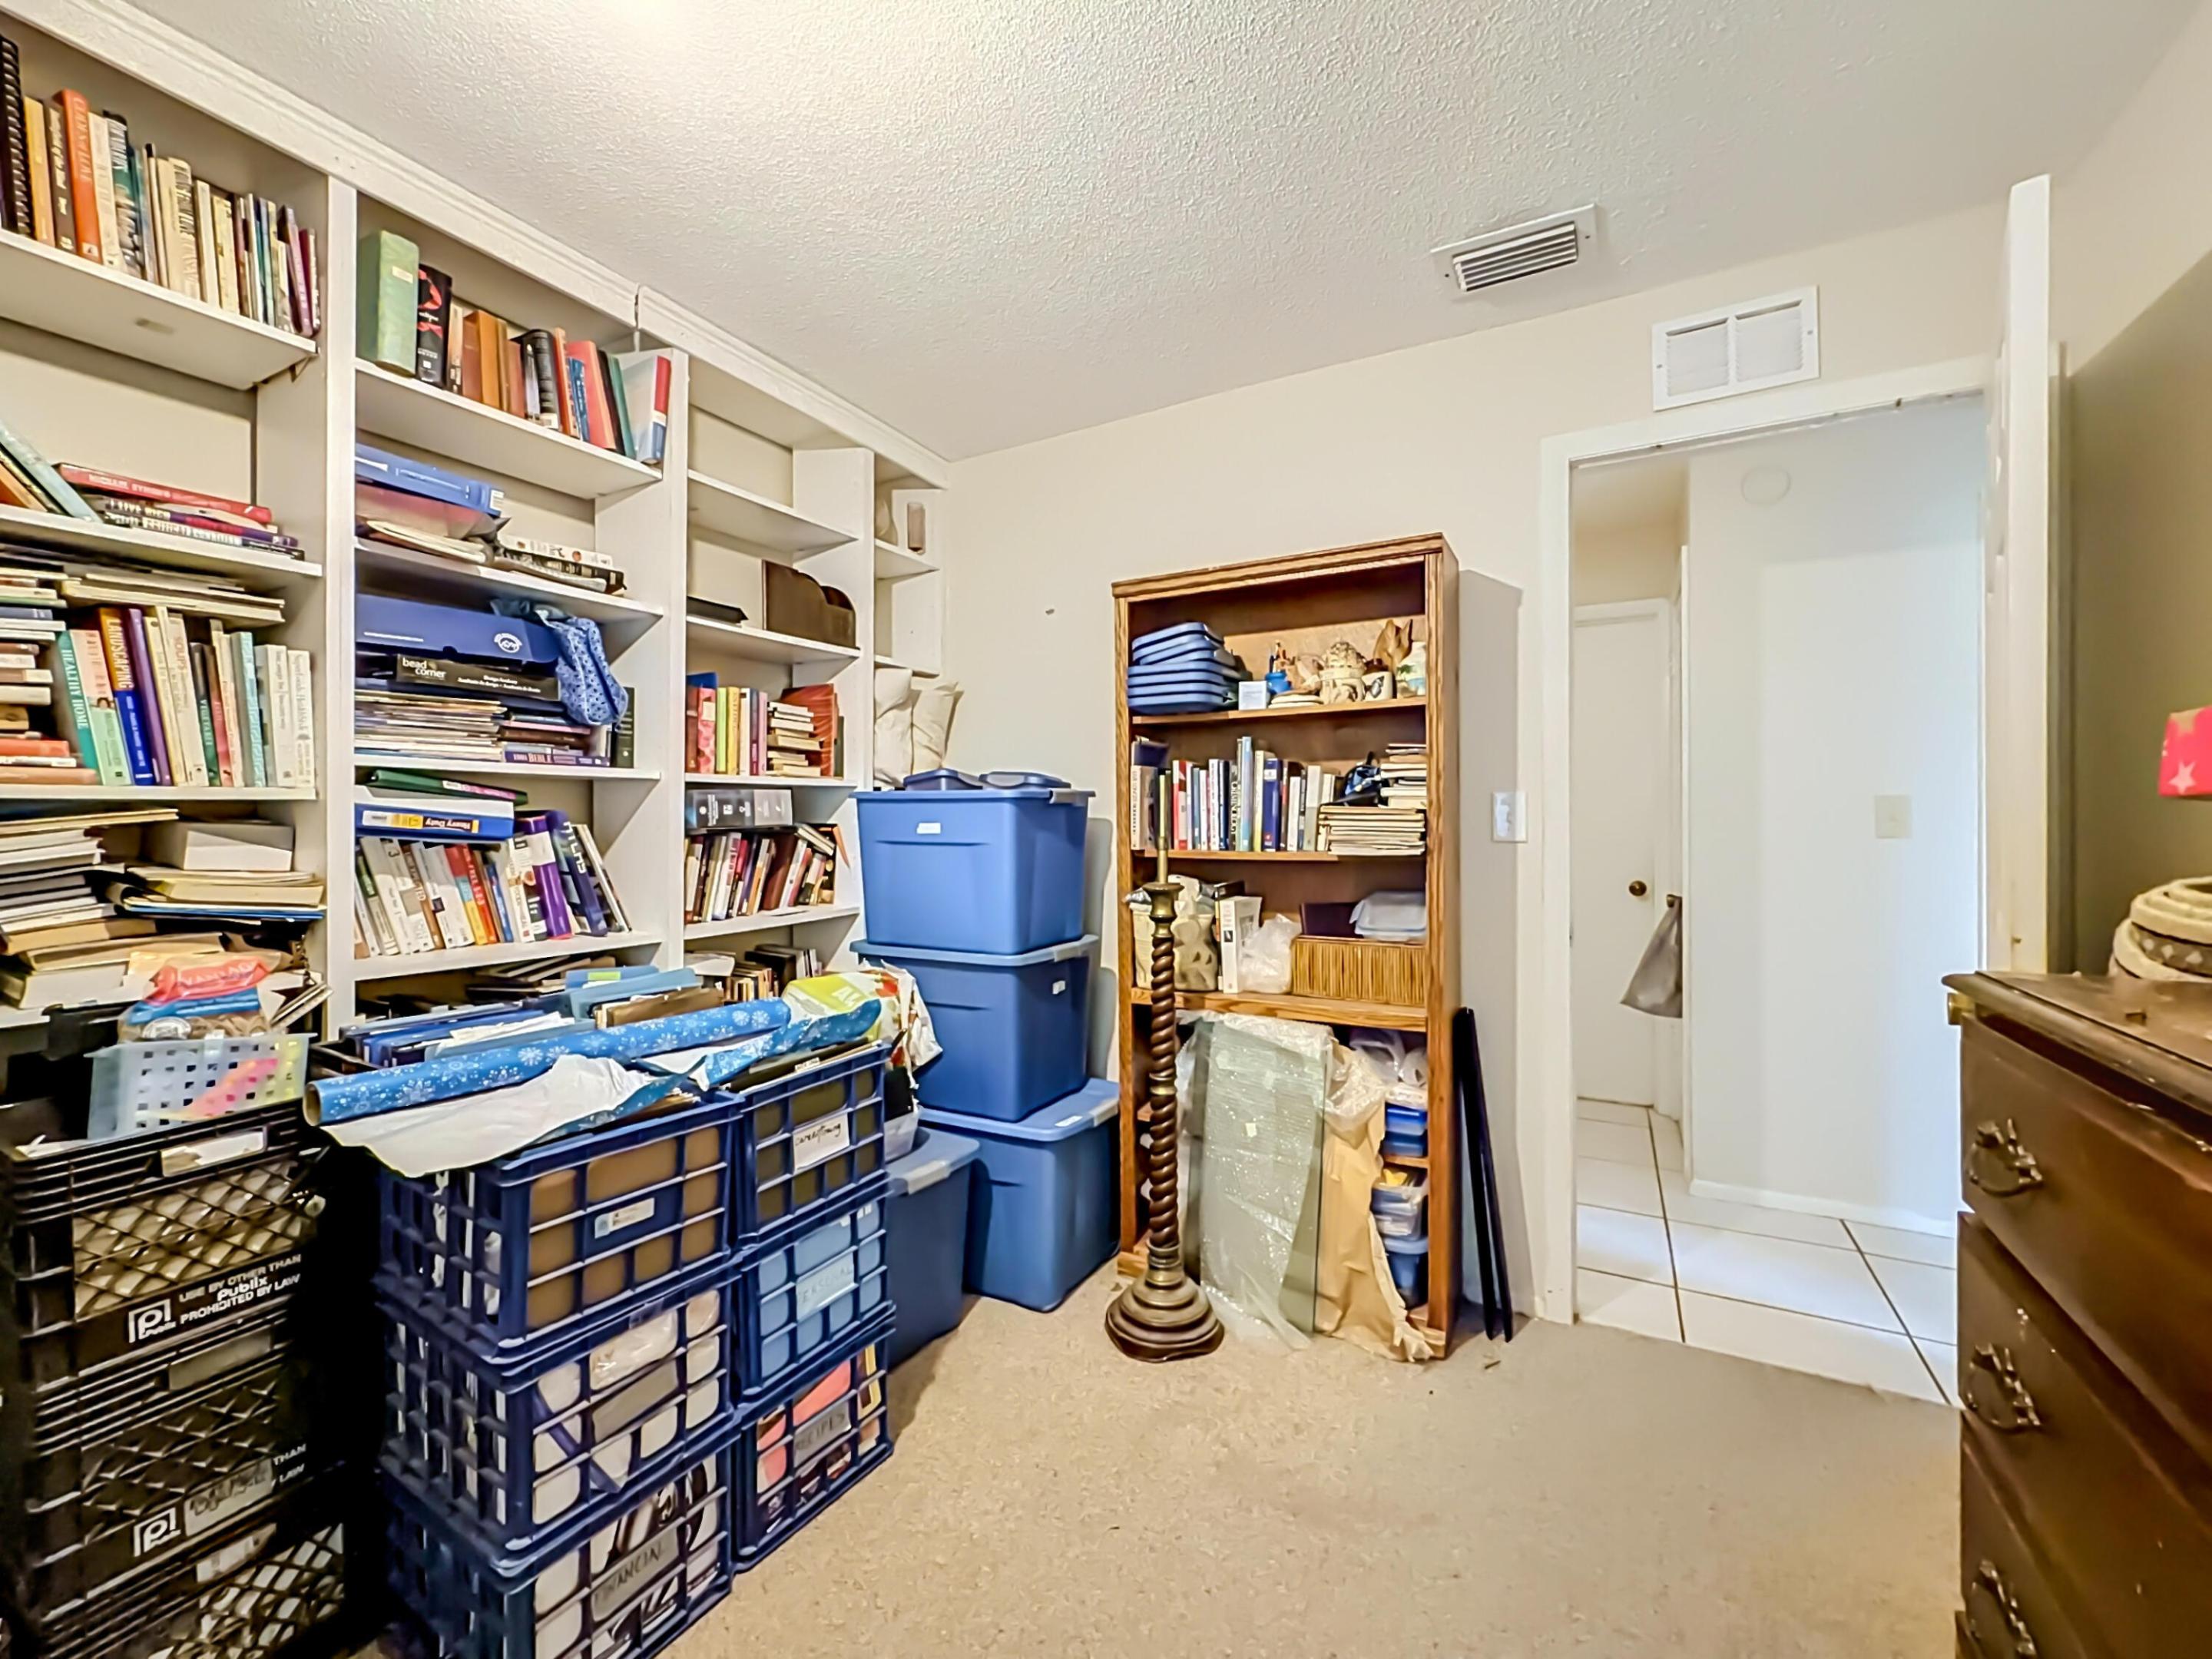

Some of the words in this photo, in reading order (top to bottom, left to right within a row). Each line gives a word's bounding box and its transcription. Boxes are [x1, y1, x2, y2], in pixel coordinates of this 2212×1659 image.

[105, 616, 134, 690] LANDSCAPING
[402, 657, 428, 670] bead
[61, 648, 82, 697] HEALTHY
[415, 667, 447, 679] corner
[71, 699, 89, 730] HOME
[425, 817, 446, 828] Duty
[178, 1286, 206, 1303] USE
[208, 1279, 226, 1293] BY
[227, 1266, 267, 1286] OTHER
[269, 1253, 302, 1273] THAN
[217, 1276, 269, 1302] Publix
[256, 1283, 273, 1299] BY
[273, 1273, 302, 1291] LAW
[272, 1443, 306, 1466] THAN
